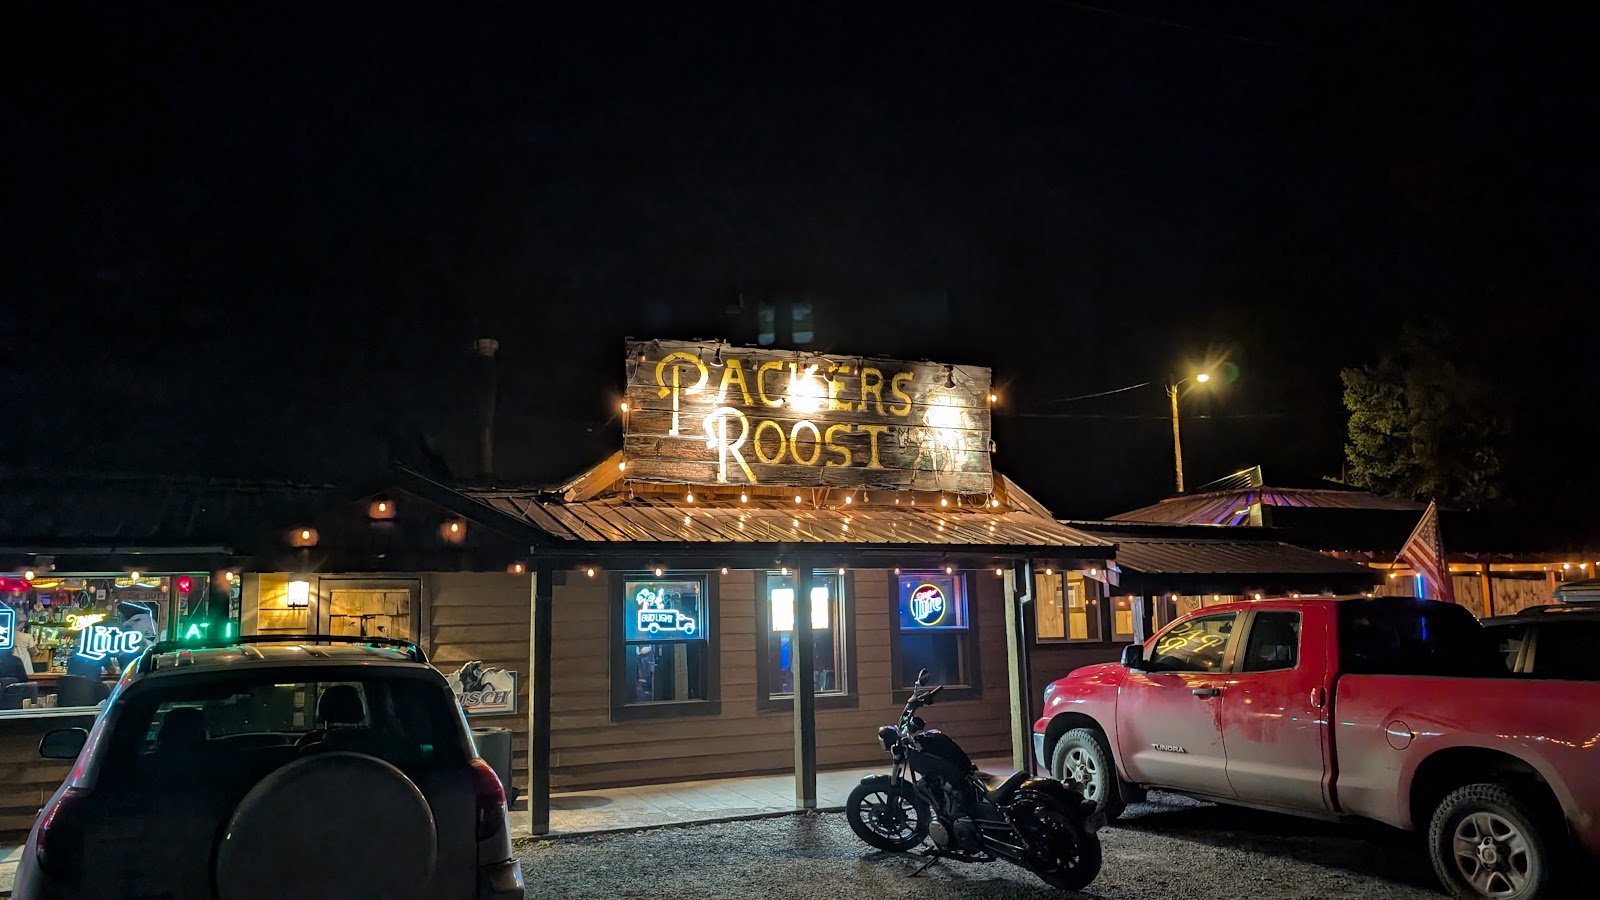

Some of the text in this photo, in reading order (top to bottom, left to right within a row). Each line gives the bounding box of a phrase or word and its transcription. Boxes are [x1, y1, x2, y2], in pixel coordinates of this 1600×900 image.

[655, 351, 915, 436] PACKERS
[702, 406, 889, 484] ROOST
[641, 613, 673, 623] BUD LIGHT
[913, 597, 943, 620] Lite
[76, 625, 143, 661] Lite
[456, 690, 511, 706] USCH
[1151, 743, 1185, 754] TUNDRA
